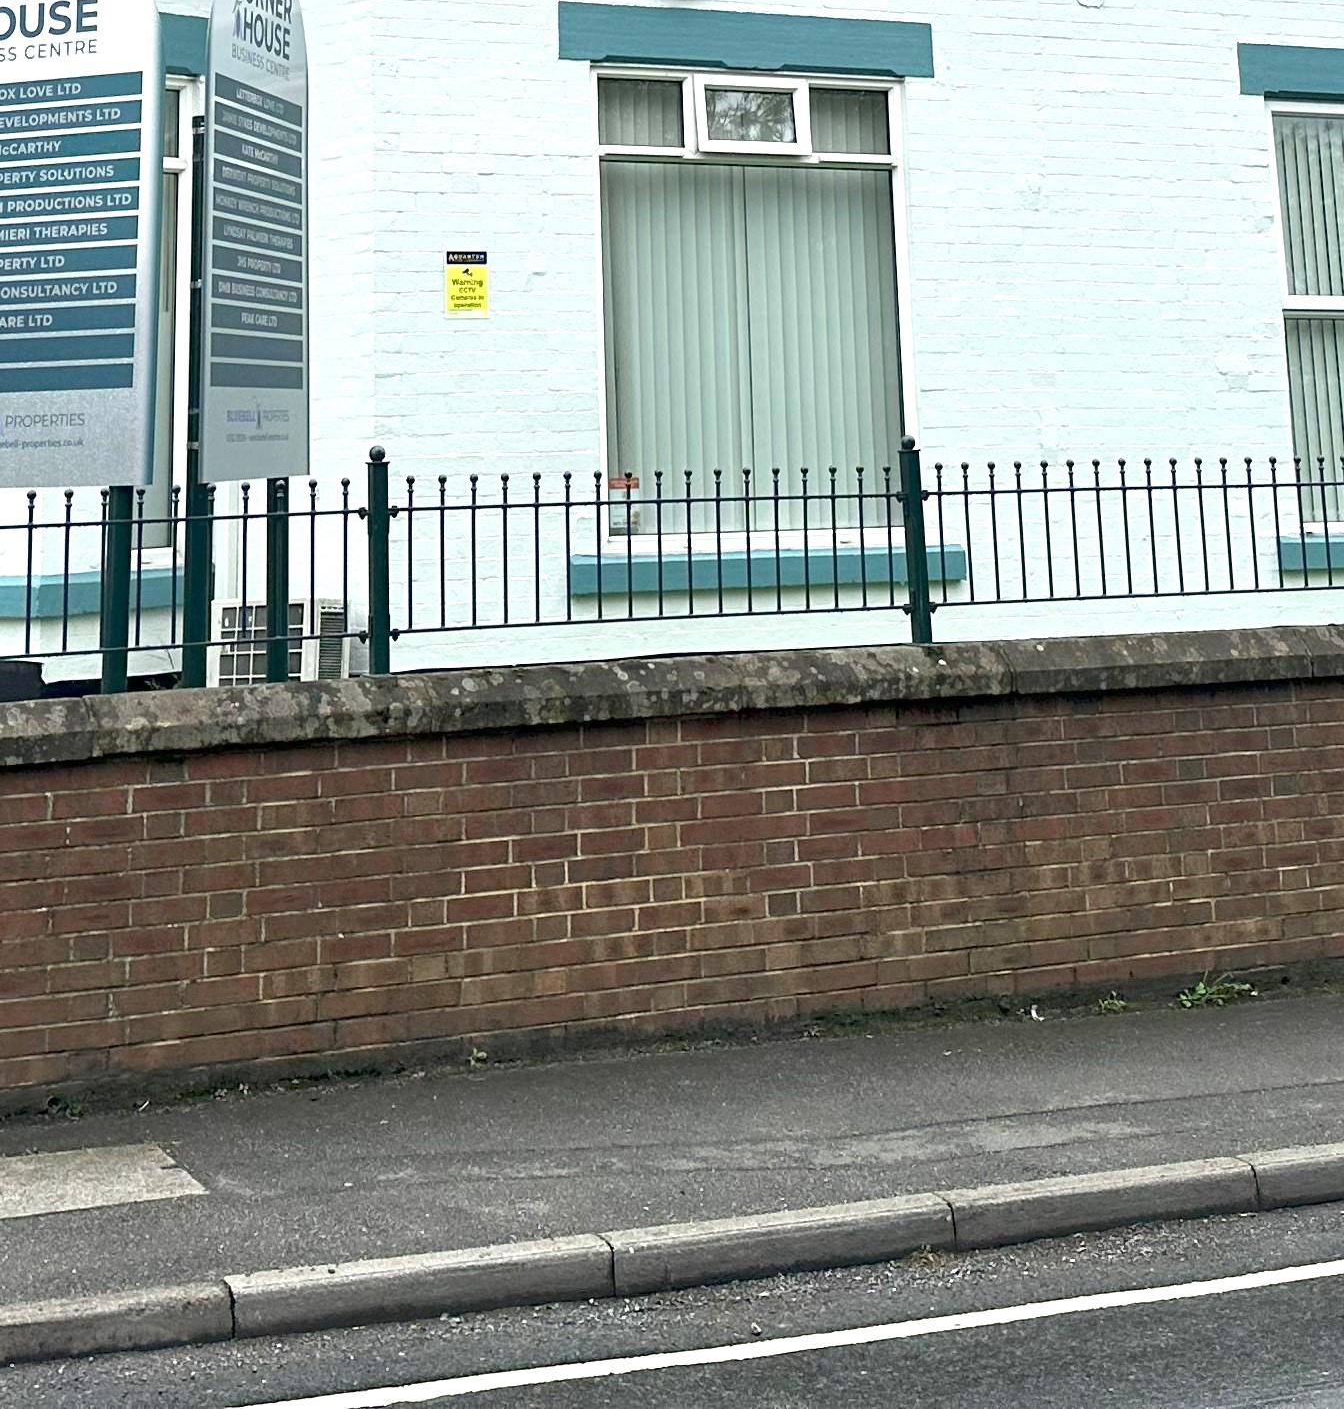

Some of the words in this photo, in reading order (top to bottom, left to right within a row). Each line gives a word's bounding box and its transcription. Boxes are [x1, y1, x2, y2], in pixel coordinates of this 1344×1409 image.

[243, 6, 291, 61] HOUSE
[24, 39, 98, 60] CENTRE
[231, 42, 264, 70] BUSINESS
[266, 58, 290, 81] CENTRE
[19, 84, 54, 100] LOVE
[57, 83, 82, 96] LTD
[96, 108, 121, 121] LTD
[39, 165, 115, 182] SOLUTIONS
[7, 195, 103, 213] PRODUCTIONS
[106, 193, 132, 206] LTD
[34, 223, 108, 239] THERAPIES
[40, 255, 65, 268] LTD
[92, 281, 118, 294] LTD
[451, 278, 484, 288] Warning
[28, 314, 53, 327] LTD
[6, 413, 86, 428] PROPERTIES
